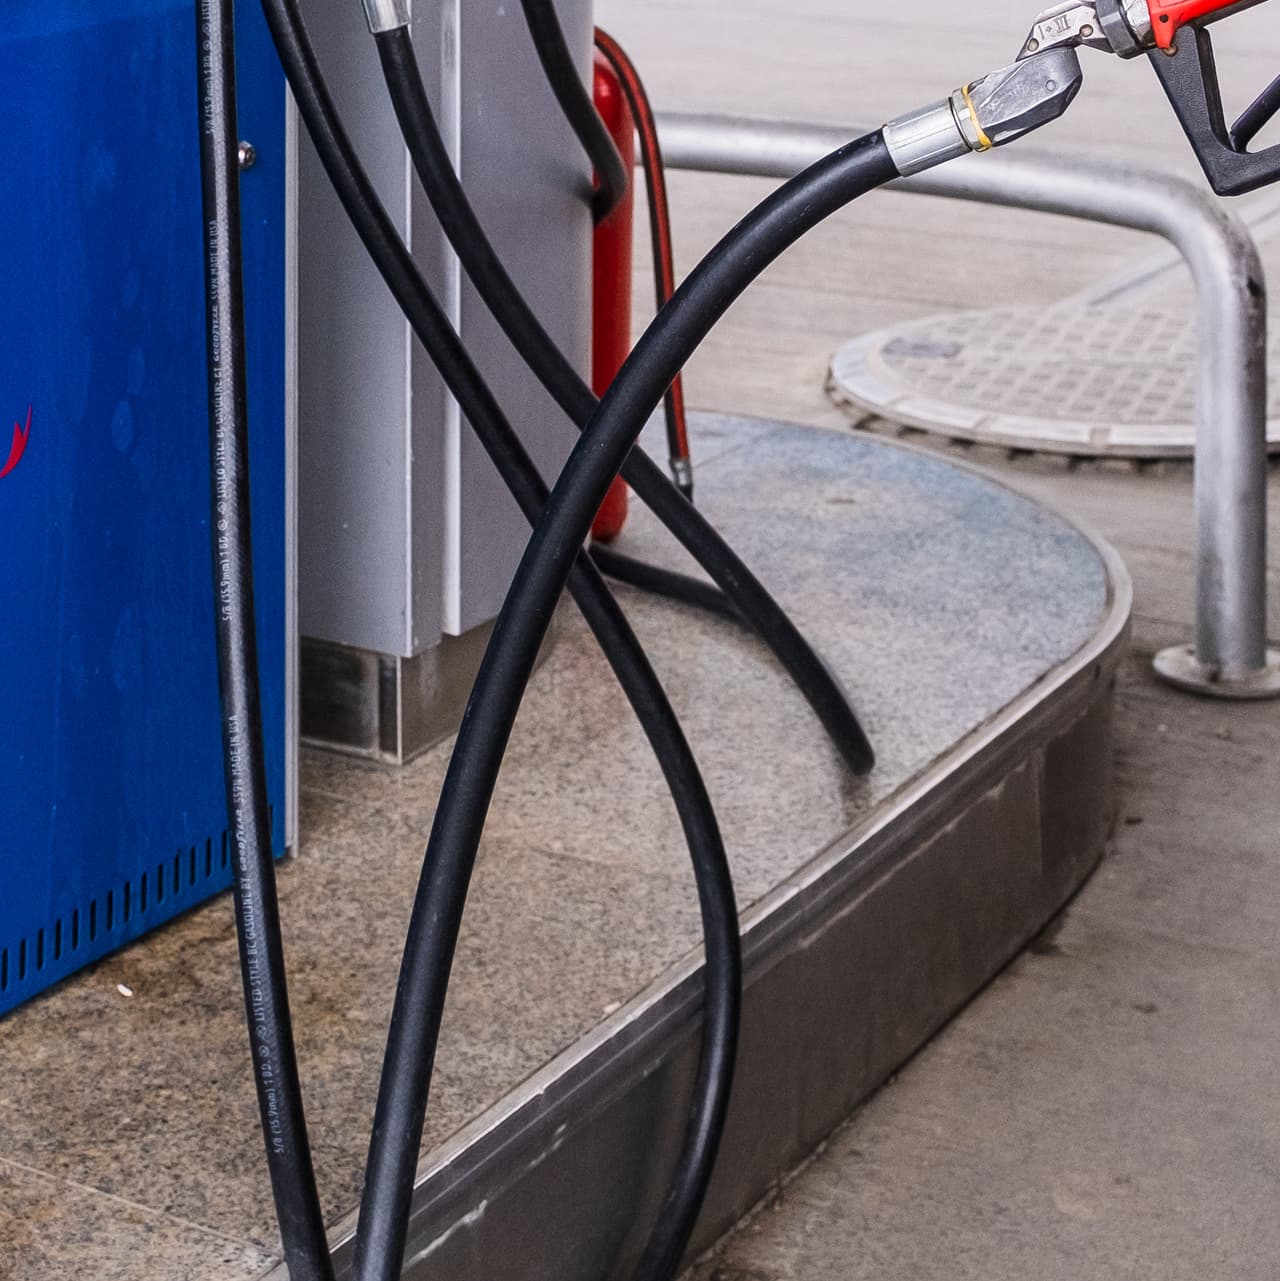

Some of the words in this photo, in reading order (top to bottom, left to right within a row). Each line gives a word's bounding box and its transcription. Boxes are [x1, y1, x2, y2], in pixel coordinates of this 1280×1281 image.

[228, 715, 239, 732] USA
[229, 736, 240, 746] IN
[229, 749, 243, 776] MADE
[235, 810, 249, 871] GOODYEAR
[240, 878, 252, 890] BY
[241, 891, 257, 940] GASOLINE
[246, 957, 261, 986] STYLE
[250, 988, 265, 1021] LISTED
